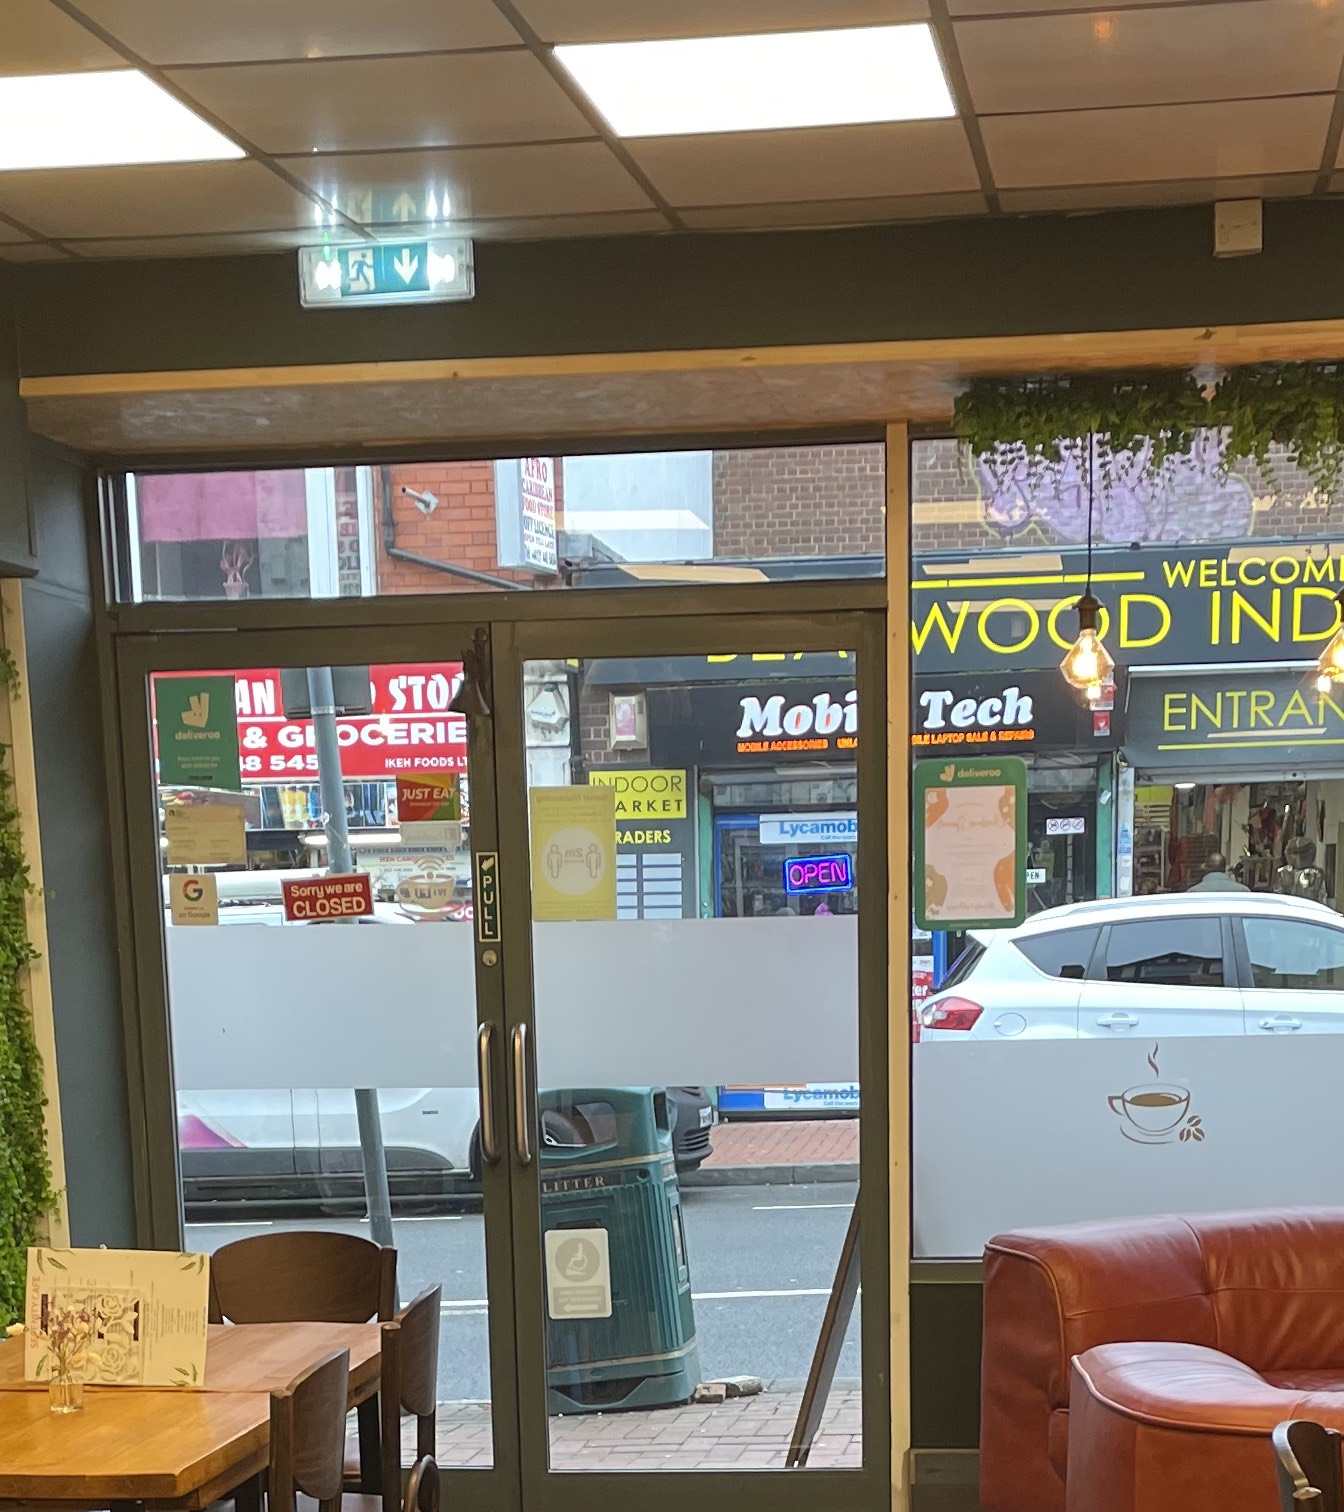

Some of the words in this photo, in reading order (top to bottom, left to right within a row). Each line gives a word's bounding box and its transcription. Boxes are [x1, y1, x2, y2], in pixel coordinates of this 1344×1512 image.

[524, 458, 548, 483] AFRO
[912, 594, 1172, 656] WOOD
[235, 678, 276, 715] AN
[388, 673, 465, 711] STO
[736, 690, 857, 738] Mobi
[920, 687, 1033, 729] Tech
[175, 730, 221, 741] deliveroo
[242, 726, 268, 749] &
[277, 721, 467, 748] GOCERIE
[931, 732, 964, 744] LAPTOP
[414, 757, 455, 768] FOODS
[957, 767, 1002, 779] deliveroo
[592, 775, 683, 793] INDOOR
[401, 788, 432, 801] JUST
[433, 787, 457, 799] EAT
[615, 799, 683, 813] ARKET
[615, 829, 672, 844] RADERS
[779, 819, 857, 837] Lycamob
[789, 861, 847, 886] OPEN
[1026, 871, 1040, 879] PEN
[183, 879, 203, 902] G
[291, 884, 324, 898] Sorry
[327, 883, 342, 895] we
[344, 881, 363, 893] are
[293, 897, 366, 917] CLOSED
[482, 875, 494, 935] PULL
[783, 1085, 858, 1103] Lycamob
[542, 1175, 605, 1193] LITTER
[32, 1275, 41, 1301] CAFE
